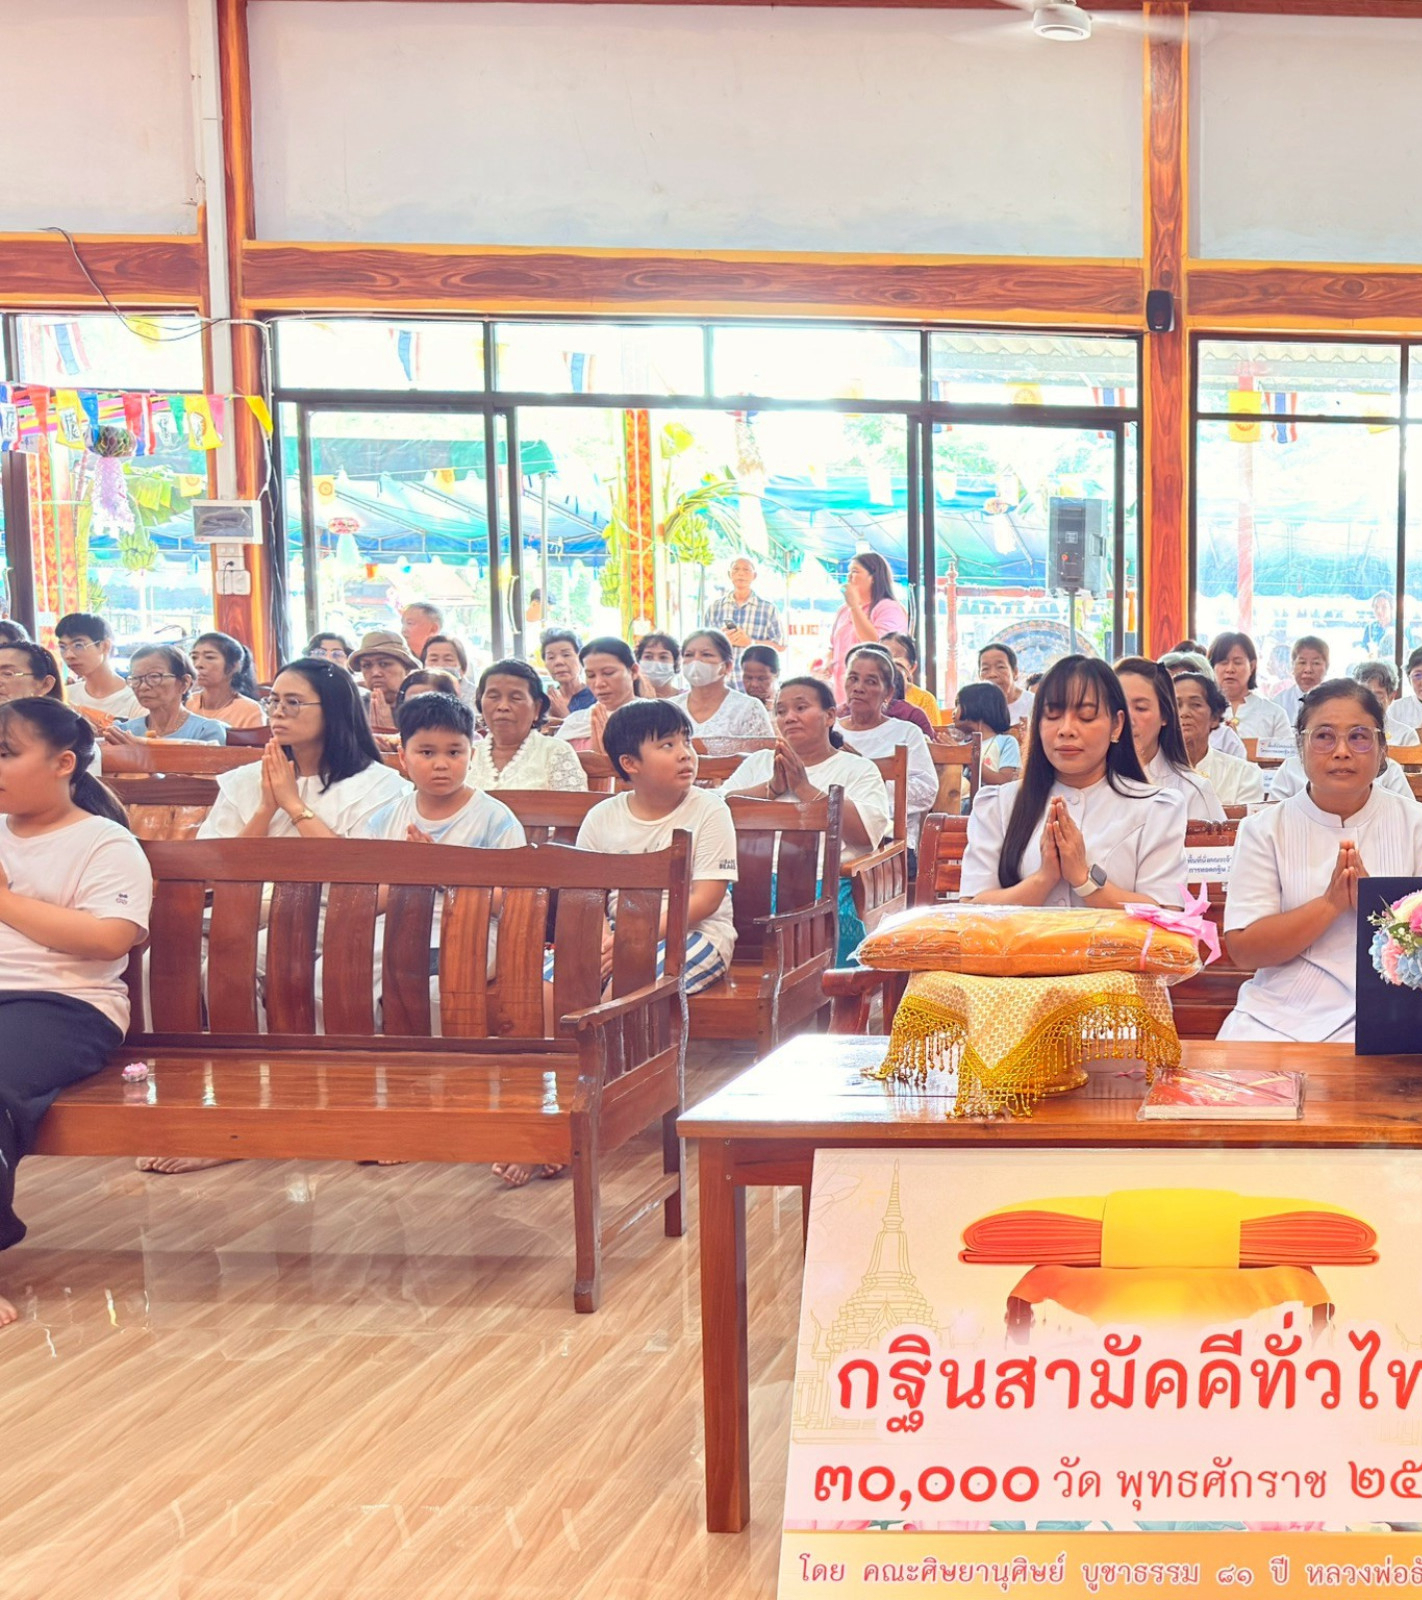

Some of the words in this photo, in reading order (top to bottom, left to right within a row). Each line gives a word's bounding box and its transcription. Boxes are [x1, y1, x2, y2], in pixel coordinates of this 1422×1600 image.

[814, 1464, 1040, 1511] ๓๐,๐๐๐
[1053, 1456, 1101, 1498] วัด
[1117, 1457, 1327, 1511] พุทธศักราช
[799, 1553, 845, 1582] โดย
[863, 1552, 1064, 1591] คณะศิษยานุศิษย์
[1083, 1563, 1199, 1592] บูชาธรรม
[1217, 1565, 1254, 1584] ๘๑
[1270, 1556, 1289, 1583] ปี
